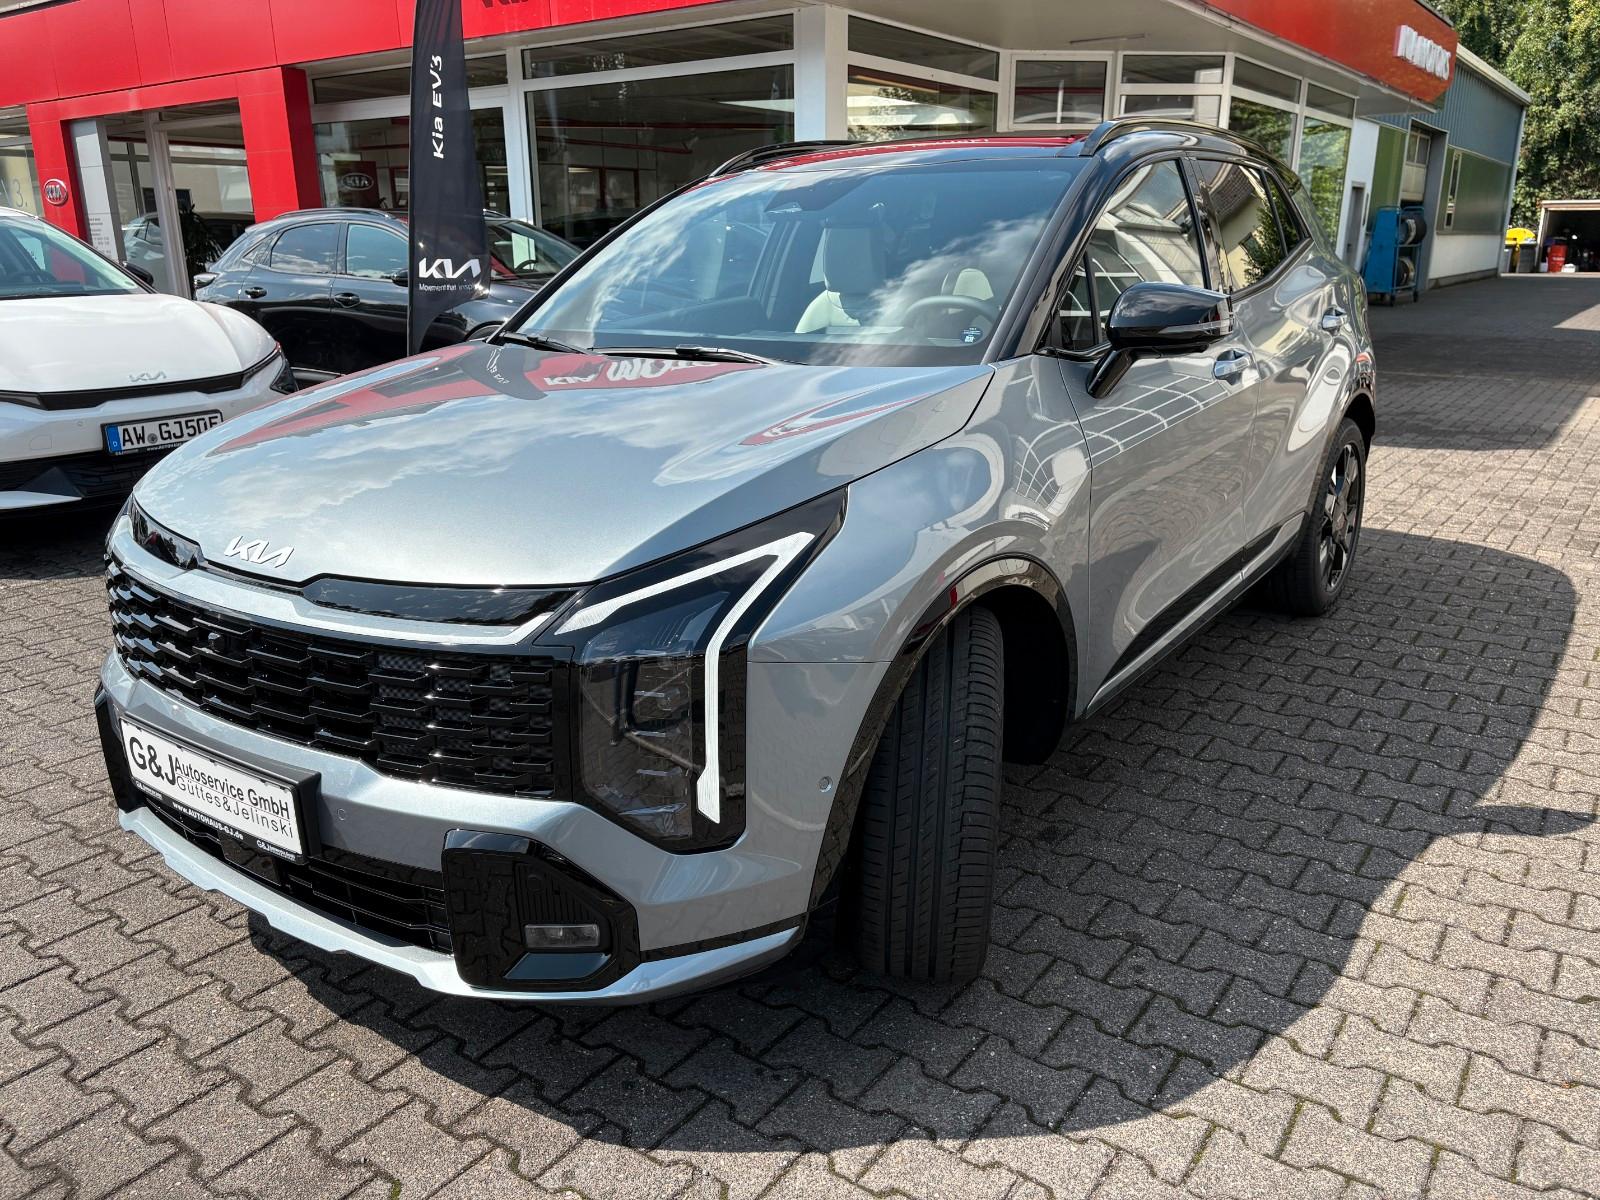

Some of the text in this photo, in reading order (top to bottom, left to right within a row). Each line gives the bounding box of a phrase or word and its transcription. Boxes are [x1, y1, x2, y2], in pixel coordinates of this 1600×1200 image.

[430, 54, 444, 159] Kia EV3
[418, 257, 482, 279] KIA
[129, 370, 167, 383] KIA
[122, 425, 146, 447] AW
[223, 535, 295, 569] KIA
[129, 736, 176, 786] G&J
[174, 756, 244, 802] Autoservice
[247, 788, 290, 820] GmbH
[176, 775, 293, 839] Güttes&Jelinski
